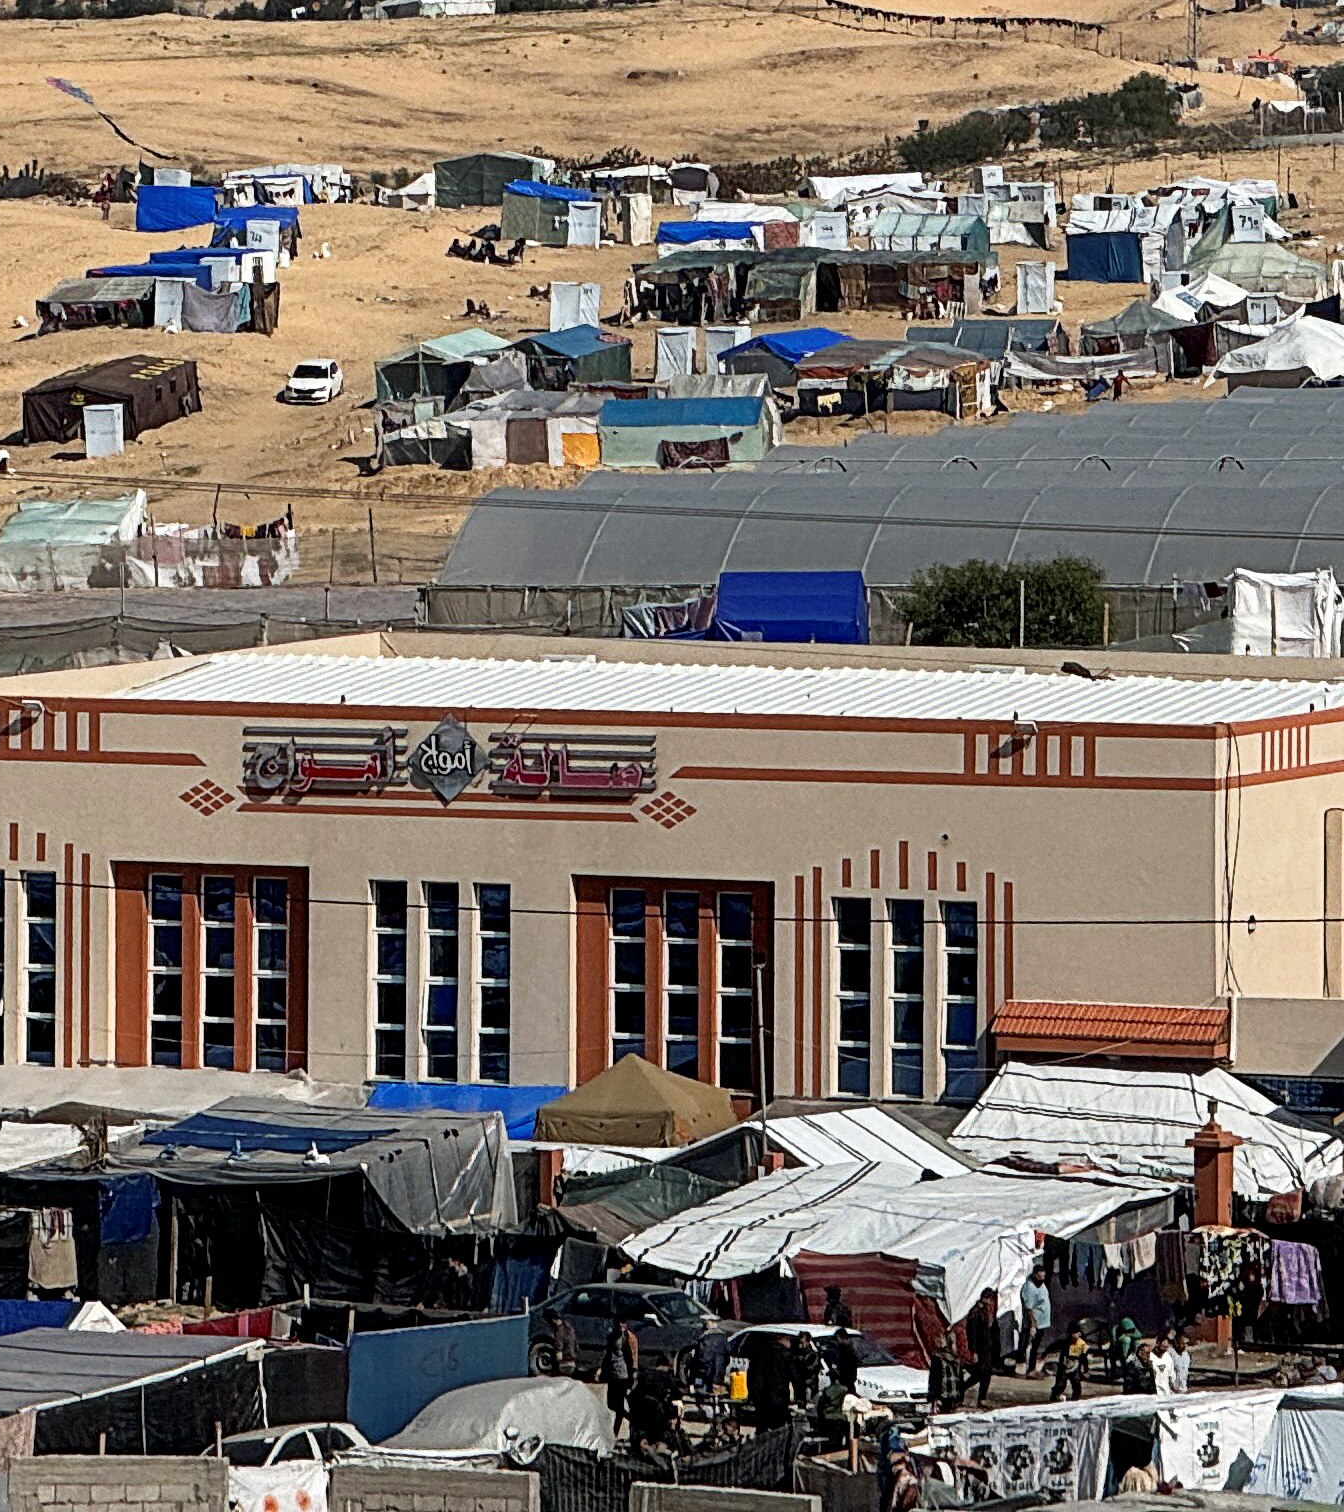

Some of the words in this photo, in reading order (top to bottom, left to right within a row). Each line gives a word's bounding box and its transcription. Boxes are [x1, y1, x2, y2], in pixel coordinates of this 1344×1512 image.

[257, 727, 395, 792] أمواج
[420, 734, 473, 776] أمواج
[503, 733, 643, 788] صالة
